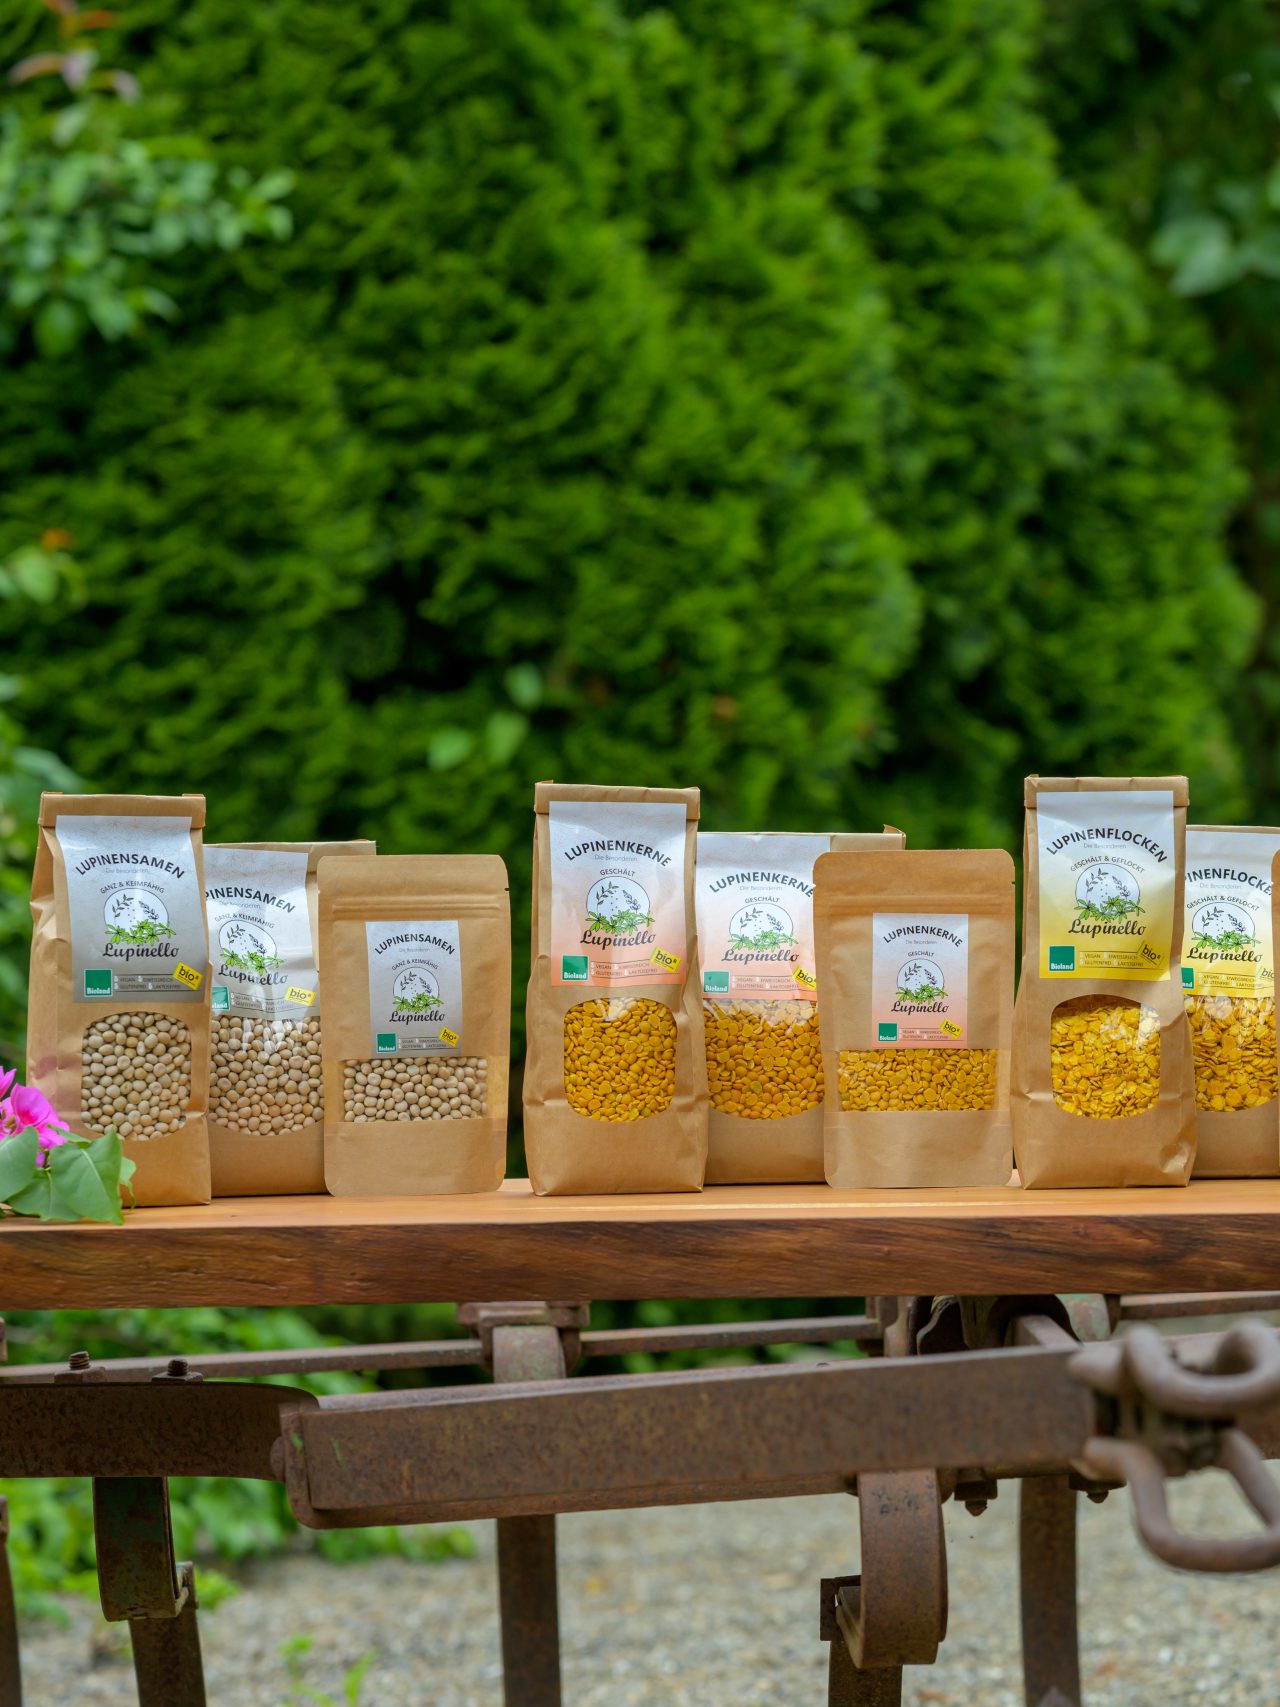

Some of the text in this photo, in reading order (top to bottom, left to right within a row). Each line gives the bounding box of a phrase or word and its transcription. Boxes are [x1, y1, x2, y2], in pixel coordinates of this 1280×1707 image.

[564, 840, 672, 867] LUPINENKERNE
[1046, 828, 1167, 863] LUPINENFLOCKEN
[75, 853, 185, 878] LUPINENSAMEN
[600, 869, 635, 877] GESCHÄLT
[1070, 855, 1102, 872] GESCHÄLT
[1111, 857, 1145, 873] GEFLOCKT
[100, 882, 117, 894] GANZ
[709, 872, 813, 898] LUPINENKERNE
[1185, 868, 1272, 895] INENFLOCKE
[1187, 896, 1218, 909] GESCHÄLT
[1227, 895, 1260, 911] GEFLOCKT
[883, 926, 963, 947] LUPINENKERNE
[1068, 919, 1146, 938] Lupinello
[375, 934, 455, 955] LUPINENSAMEN
[580, 930, 656, 950] Lupinello
[103, 943, 179, 961] Lupinello
[721, 949, 799, 965] Lupinello
[1187, 946, 1262, 963] Lupinello
[218, 964, 288, 985] Lupinello
[392, 961, 405, 971] GANZ
[891, 1001, 949, 1015] Lupinello
[389, 1011, 445, 1025] Lupinello
